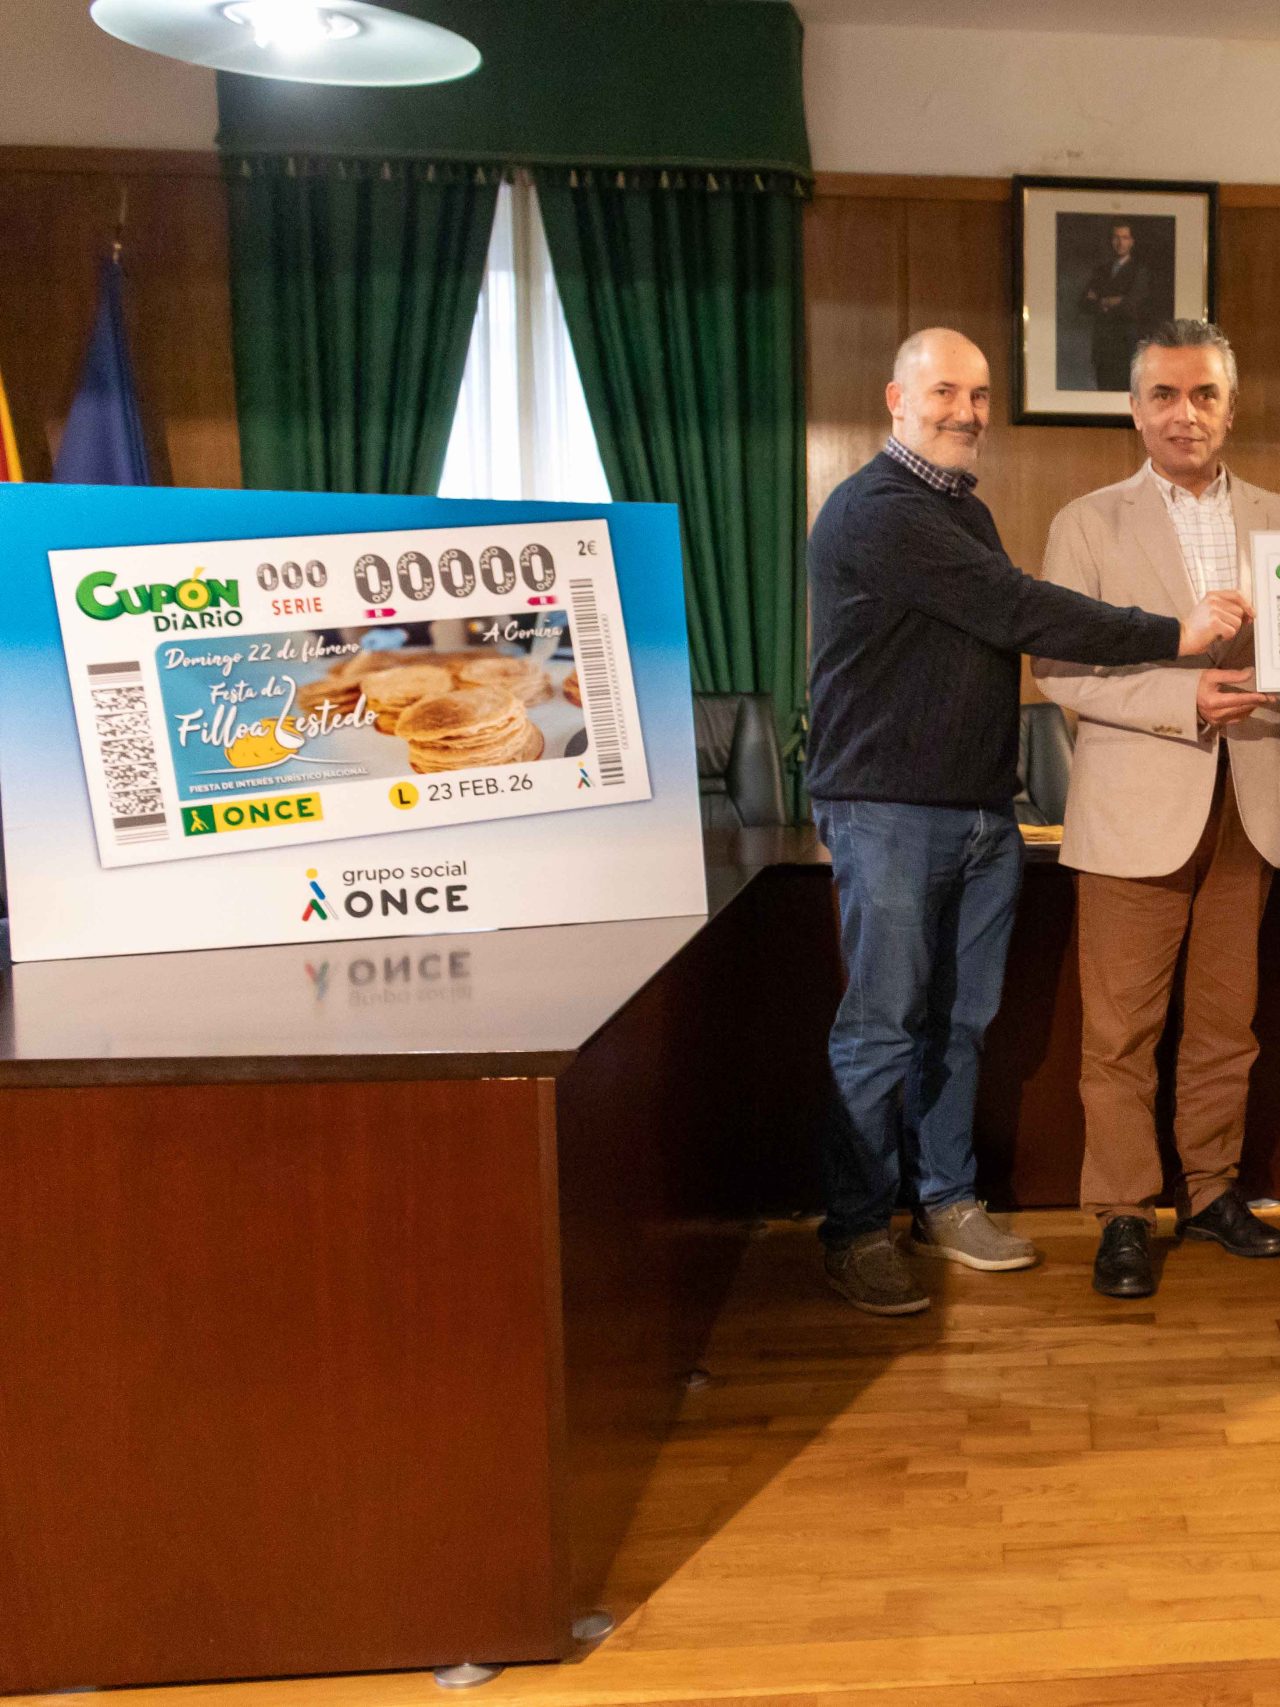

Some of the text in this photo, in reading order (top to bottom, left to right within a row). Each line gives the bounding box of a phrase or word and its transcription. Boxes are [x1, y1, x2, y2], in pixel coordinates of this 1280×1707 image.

[577, 540, 598, 556] 2€
[256, 559, 328, 591] 000
[354, 543, 556, 604] 00000
[75, 566, 241, 621] CUPÓN
[271, 597, 323, 616] SERIE
[482, 618, 563, 642] A Coruña
[164, 636, 360, 677] Domingo 22 de febrero
[209, 676, 286, 704] Festa da
[175, 704, 270, 749] Filloa
[189, 784, 221, 794] FIESTA
[221, 781, 235, 790] DE
[235, 776, 275, 789] INTERÉS
[322, 767, 368, 780] NACIONAL
[427, 773, 533, 802] 23 FEB. 26
[398, 788, 411, 805] L
[222, 797, 315, 827] ONCE
[342, 860, 467, 886] grupo social
[344, 884, 469, 918] ONCE
